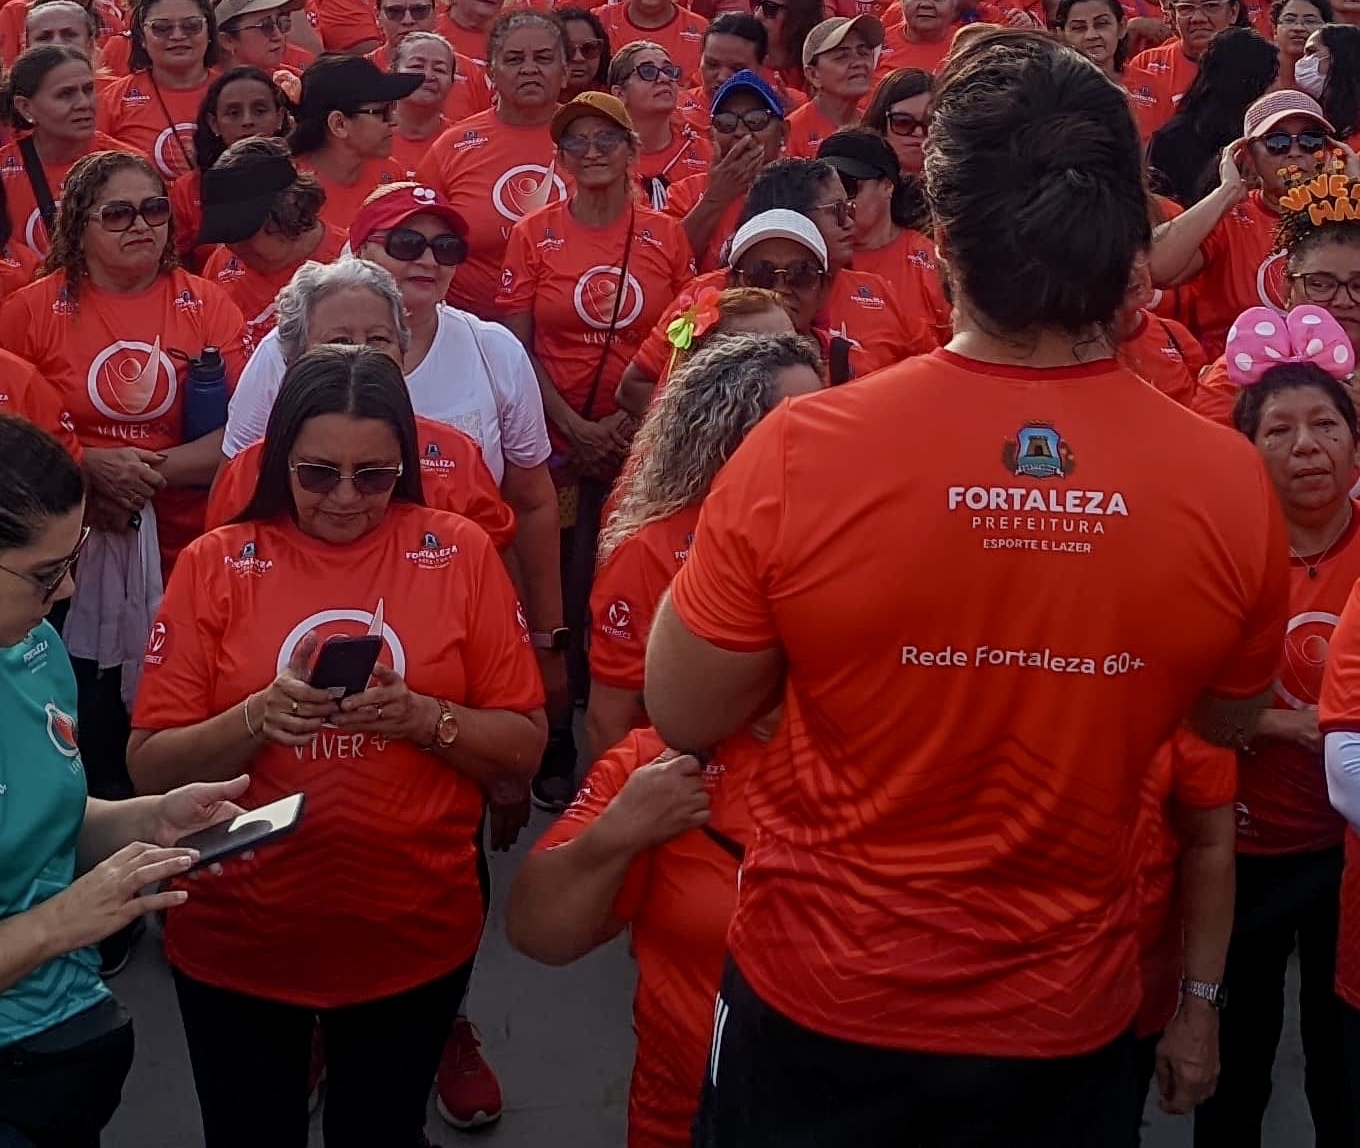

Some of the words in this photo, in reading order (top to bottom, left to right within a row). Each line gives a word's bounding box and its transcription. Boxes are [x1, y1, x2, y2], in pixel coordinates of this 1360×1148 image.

[419, 458, 456, 469] ORTALEZA
[948, 486, 1129, 516] FORTALEZA
[972, 516, 1105, 534] PREFEITURA
[983, 538, 1038, 550] ESPORTE
[1041, 541, 1049, 551] E
[1052, 542, 1092, 553] LAZER
[900, 645, 968, 667] Rede
[975, 645, 1096, 674] Fortaleza
[1103, 652, 1145, 676] 60+
